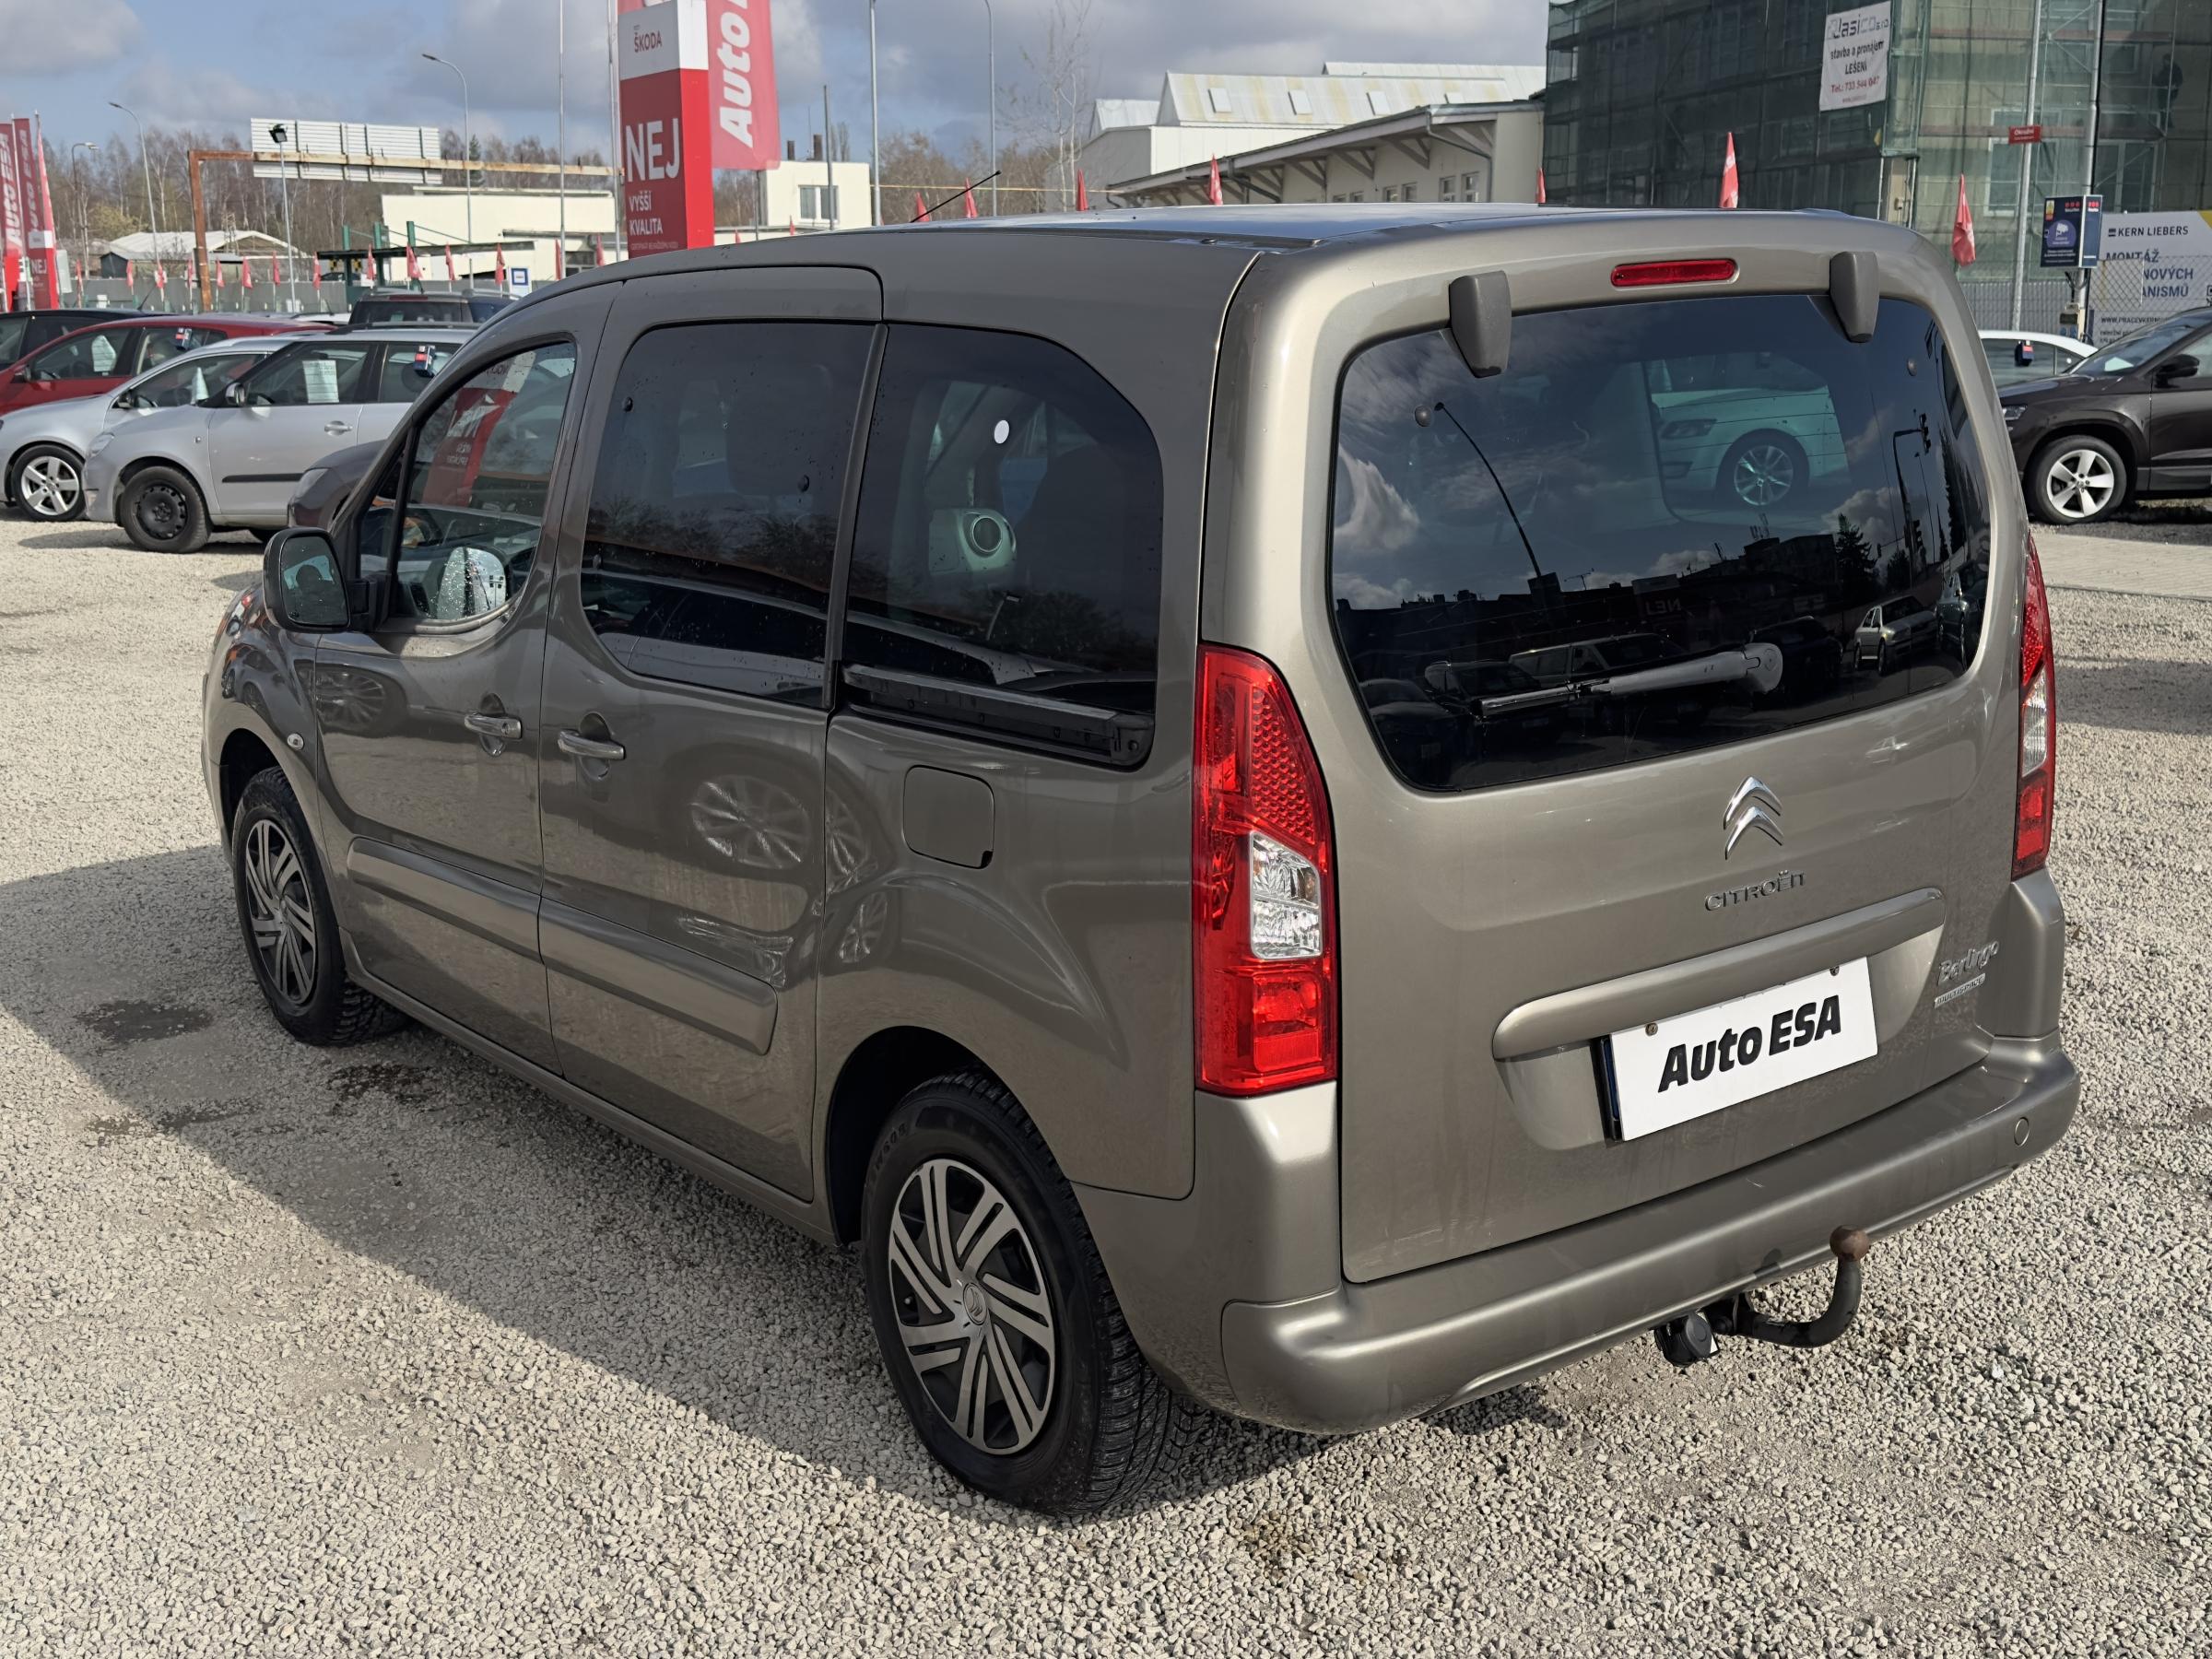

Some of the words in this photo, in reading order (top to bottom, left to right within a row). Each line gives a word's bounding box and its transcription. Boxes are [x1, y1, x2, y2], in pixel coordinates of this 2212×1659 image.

[633, 30, 662, 53] ŠKODA
[1830, 46, 1851, 60] stavba
[1852, 48, 1856, 57] a
[716, 11, 753, 148] Auto
[625, 117, 680, 182] NEJ
[629, 190, 652, 212] VYŠŠÍ
[629, 217, 664, 236] KVALITA
[2118, 227, 2145, 237] KERN
[2147, 225, 2189, 237] LIEBERS
[1705, 869, 1806, 912] CITROËN
[1936, 940, 1999, 986] Berlingo
[1658, 1028, 1763, 1093] Auto
[1769, 994, 1841, 1056] ESA
